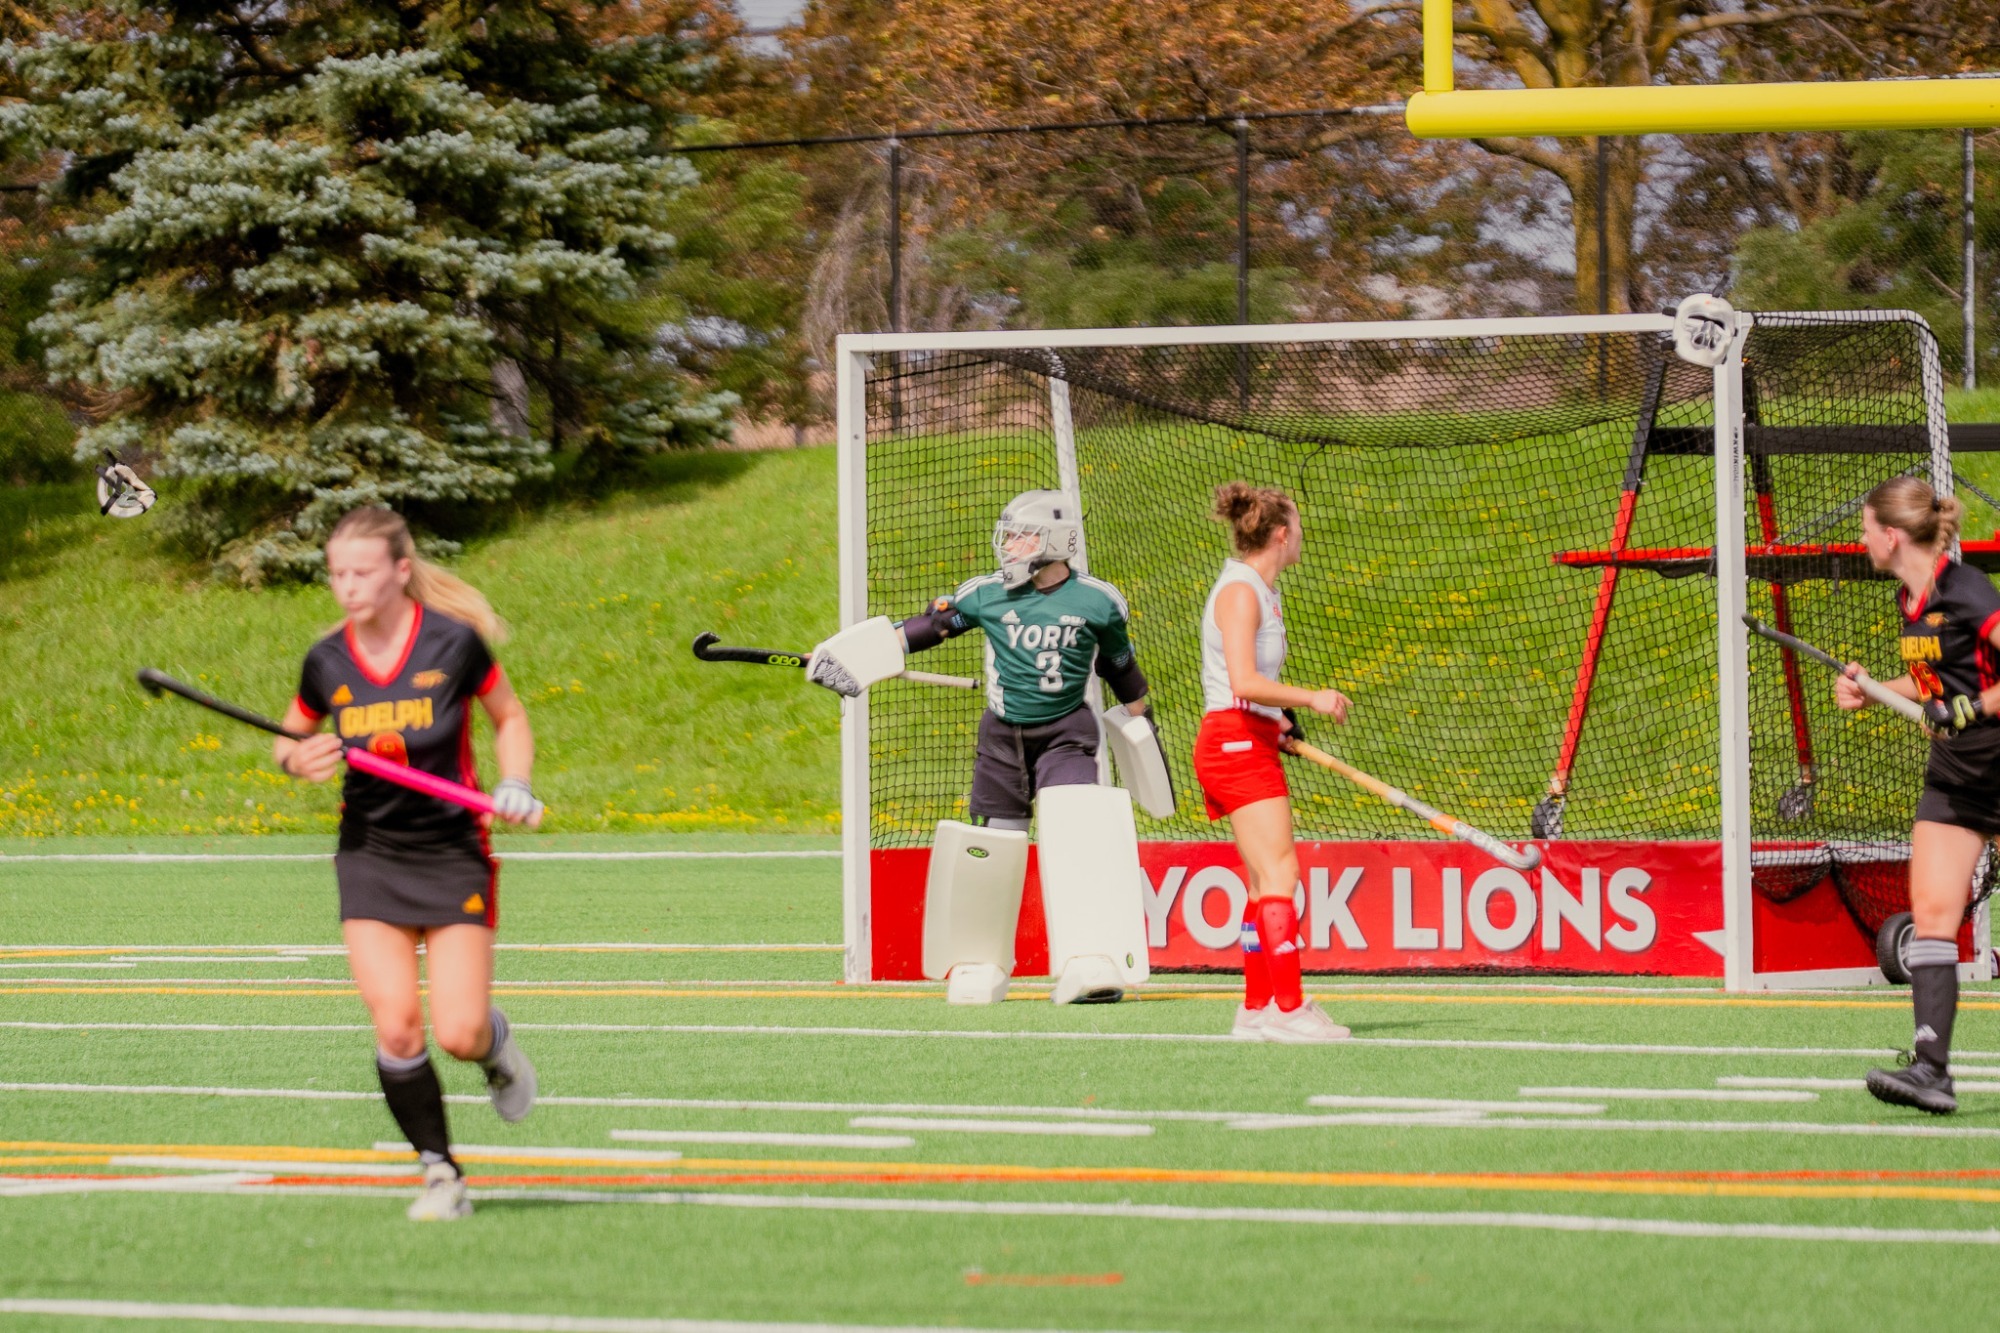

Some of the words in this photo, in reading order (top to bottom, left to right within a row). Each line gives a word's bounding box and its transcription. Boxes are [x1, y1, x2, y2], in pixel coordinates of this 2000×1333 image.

[1006, 624, 1081, 650] YORK
[1901, 635, 1943, 661] UELPH
[768, 654, 801, 667] OBO
[1035, 650, 1064, 692] 3
[339, 696, 434, 738] GUELPH
[1140, 865, 1369, 950] YOK
[1392, 866, 1657, 952] LIONS
